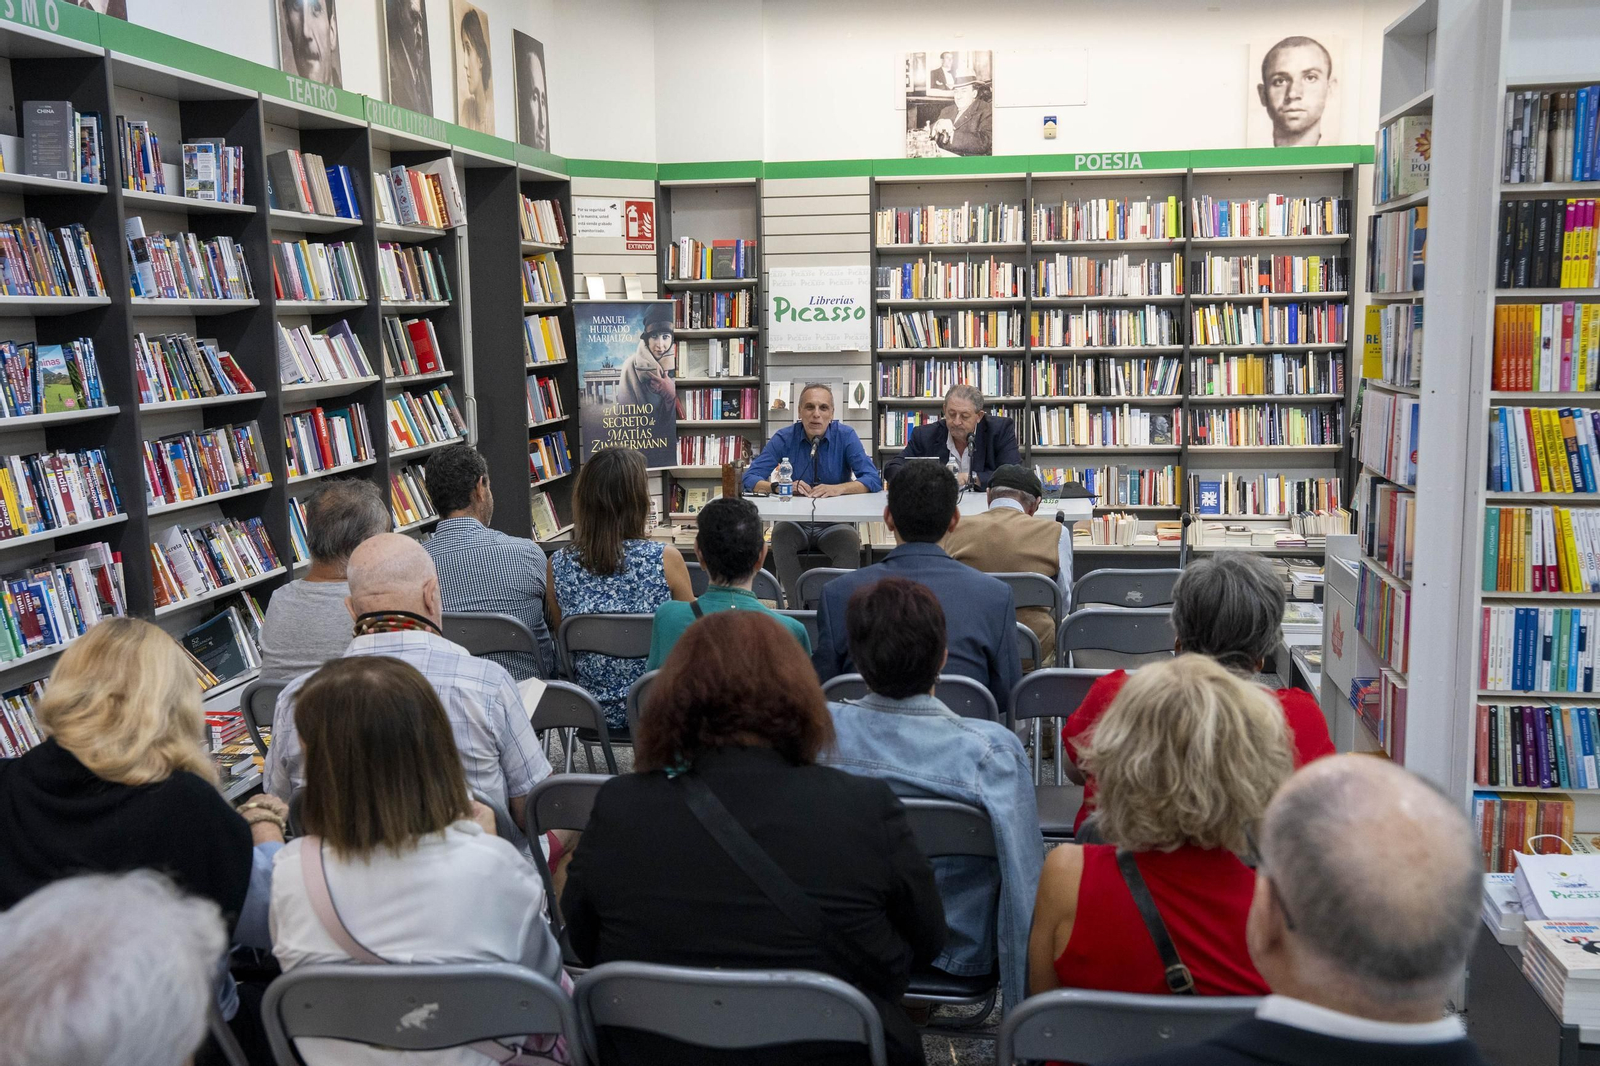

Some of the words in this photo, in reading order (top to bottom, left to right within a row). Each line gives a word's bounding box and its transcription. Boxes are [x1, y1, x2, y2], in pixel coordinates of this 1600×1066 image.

[286, 76, 338, 112] TEATRO
[406, 112, 448, 142] LITERARIA
[773, 296, 866, 322] Picasso
[809, 296, 854, 305] Librerías
[590, 325, 630, 333] HURTADO
[592, 316, 626, 324] MANUEL
[588, 334, 632, 344] MARJALIZO
[613, 403, 654, 415] ÚLTIMO
[603, 416, 648, 428] SECRETO
[649, 417, 656, 426] de
[608, 428, 652, 441] MATÍAS
[239, 440, 250, 469] Tailandia
[1571, 454, 1580, 472] ESPINOSA
[56, 469, 68, 494] India
[86, 473, 99, 507] Indonesia
[1574, 473, 1583, 488] ALBERT
[1, 500, 10, 526] Grecia
[1563, 518, 1573, 538] DYER
[16, 595, 24, 614] Italia
[24, 592, 33, 612] Italia
